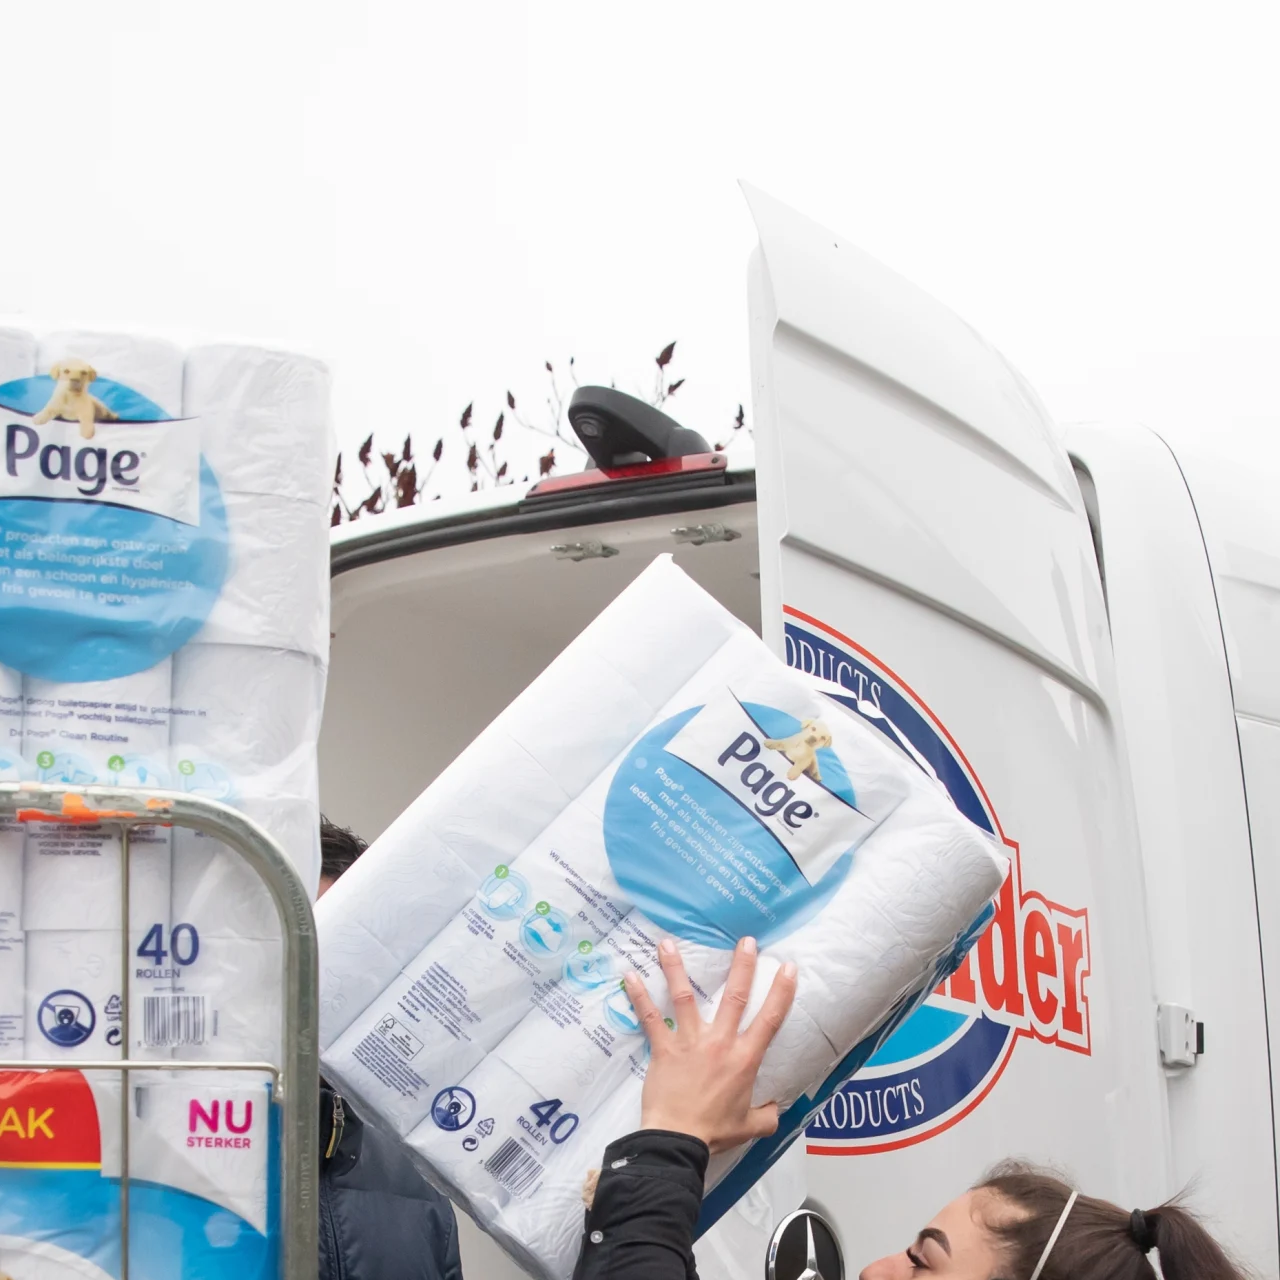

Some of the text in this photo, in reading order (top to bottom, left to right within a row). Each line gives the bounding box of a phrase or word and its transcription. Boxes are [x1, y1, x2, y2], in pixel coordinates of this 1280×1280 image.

[5, 530, 80, 547] producten
[83, 535, 108, 549] zijn
[14, 548, 34, 561] als
[37, 550, 129, 570] belangrijkste
[132, 558, 163, 571] doel
[15, 567, 41, 579] een
[44, 568, 97, 583] schoon
[100, 573, 118, 585] en
[2, 582, 25, 595] fris
[28, 584, 76, 600] gevoel
[79, 588, 94, 600] te
[627, 781, 780, 923] iedereen een schoon en hygiënisch
[648, 820, 667, 839] fris
[662, 834, 698, 868] gevoel
[694, 863, 708, 877] te
[656, 788, 771, 895] met als belangrijkste doel
[678, 791, 730, 839] producten
[724, 833, 746, 854] zijn
[740, 848, 794, 898] ontworpen
[136, 922, 200, 967] 40
[136, 968, 181, 979] ROLLEN
[187, 1097, 253, 1134] NU
[517, 1116, 547, 1145] ROLLEN
[530, 1099, 578, 1144] 40
[186, 1136, 252, 1150] STERKER
